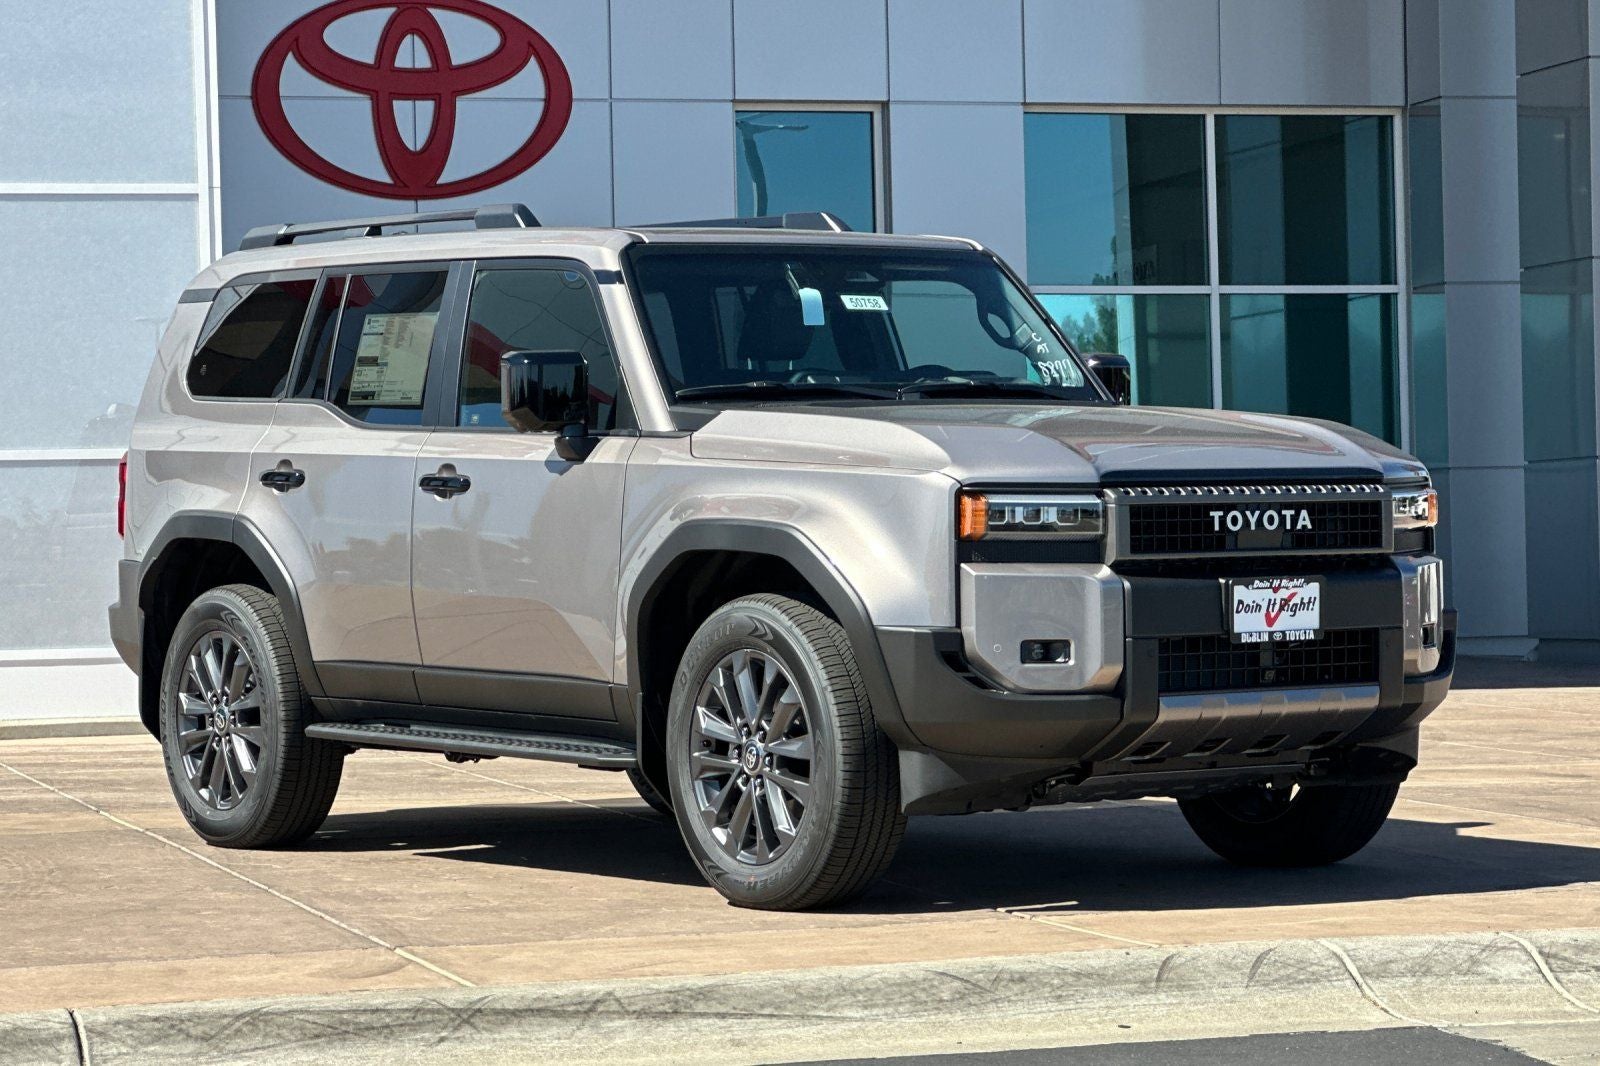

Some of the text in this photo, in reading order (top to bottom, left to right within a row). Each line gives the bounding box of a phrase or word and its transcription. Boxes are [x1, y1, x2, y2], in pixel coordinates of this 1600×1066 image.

[849, 297, 882, 309] 50758
[1209, 509, 1313, 532] TOYOTA
[1271, 578, 1280, 588] It
[1280, 578, 1305, 589] Right!
[1235, 596, 1317, 617] Doin' It Right!
[1241, 629, 1315, 643] DUBLIN TOYOTA
